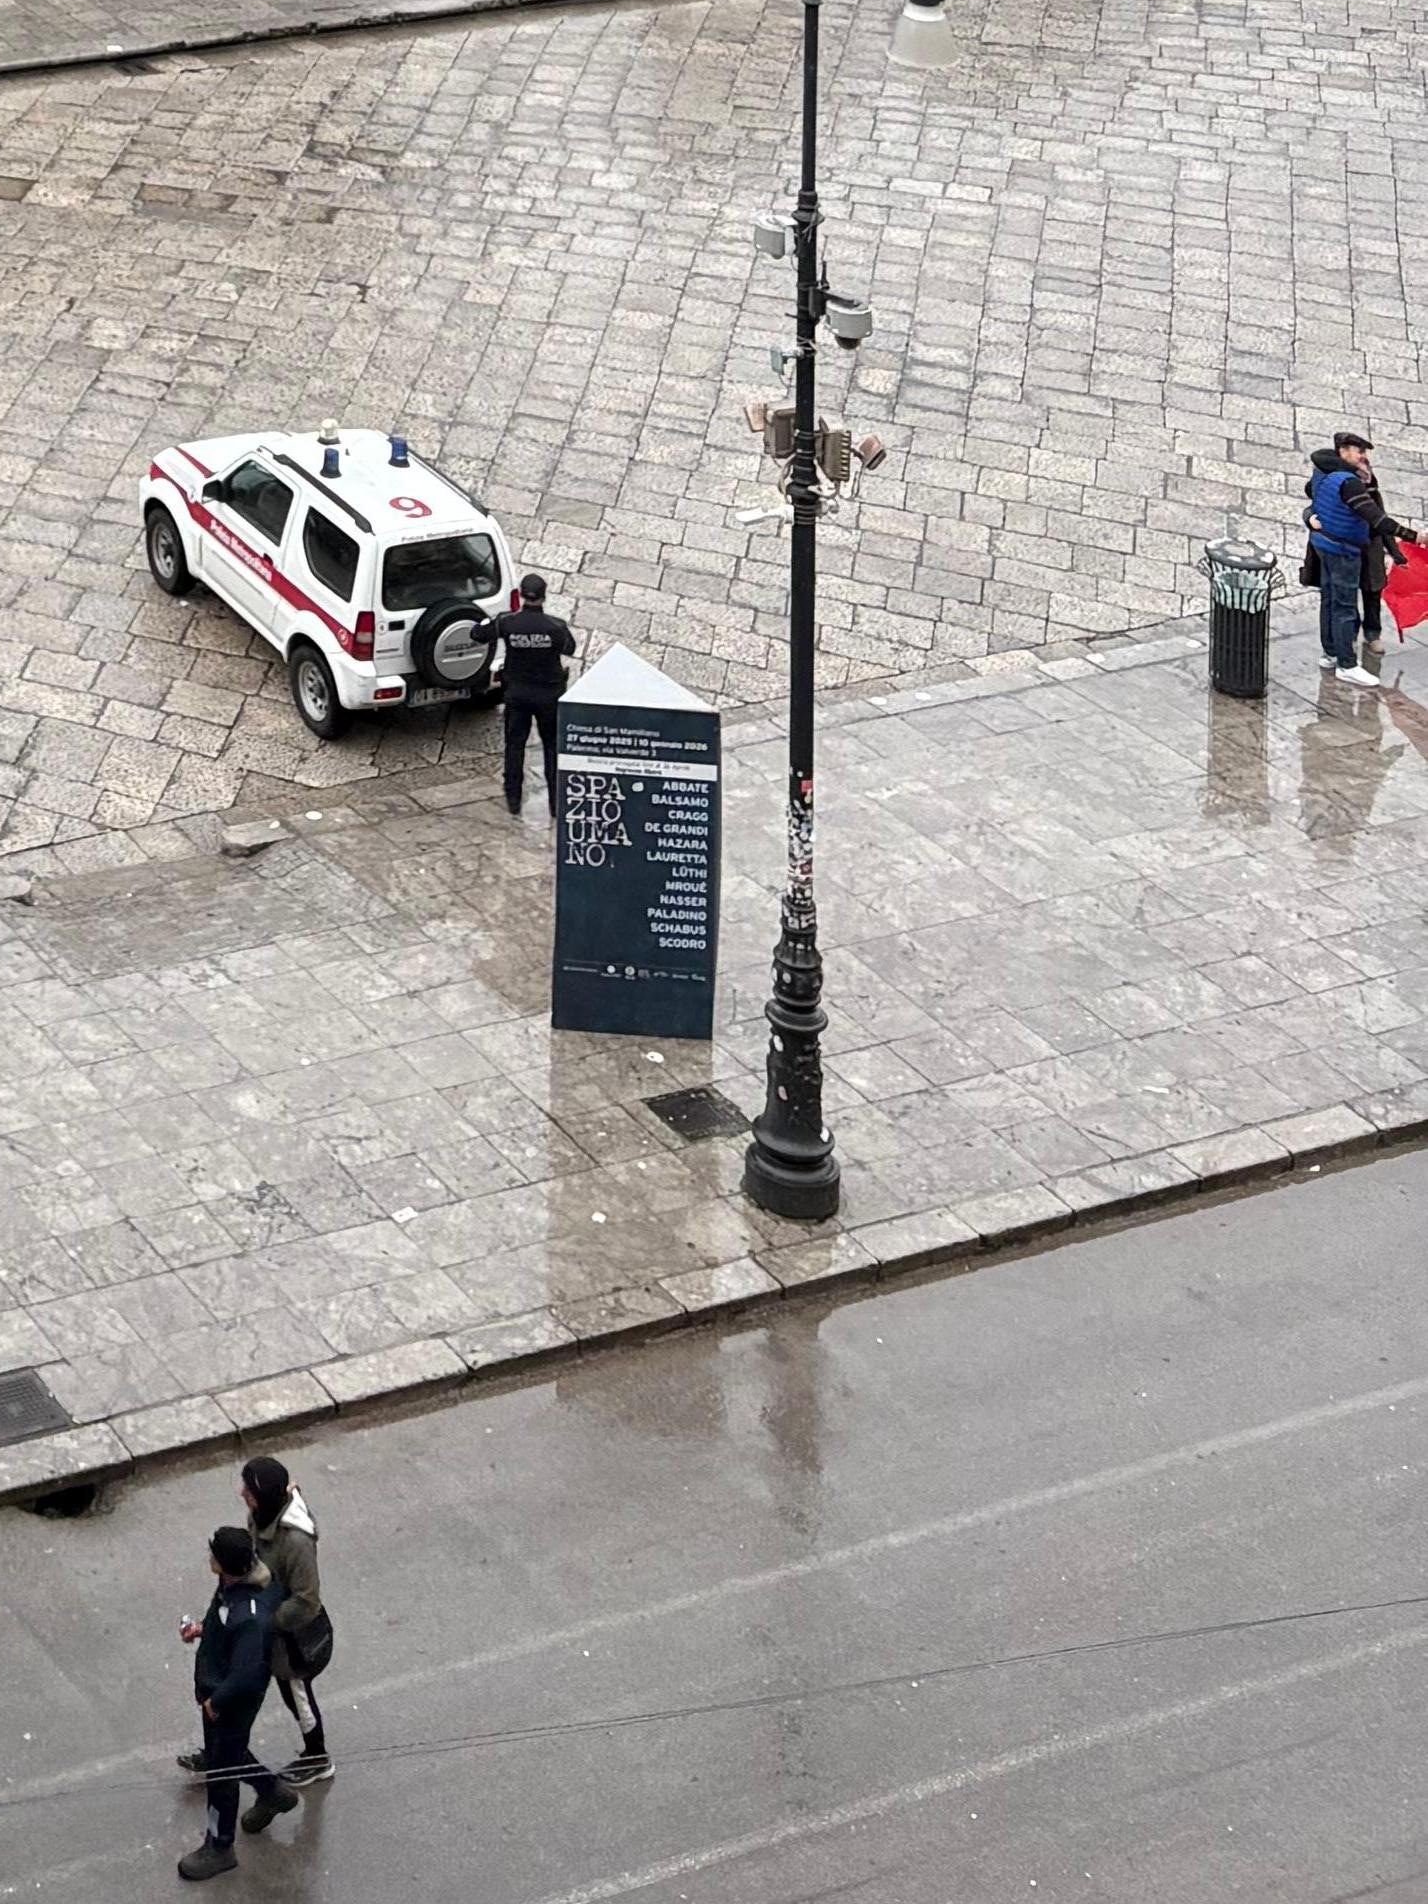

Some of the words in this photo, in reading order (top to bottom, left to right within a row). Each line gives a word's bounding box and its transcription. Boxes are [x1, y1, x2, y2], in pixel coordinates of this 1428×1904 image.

[566, 773, 626, 801] SPA
[662, 781, 709, 794] ABBATE
[651, 793, 709, 808] BALSAMO
[565, 797, 621, 824] ZIO
[667, 809, 709, 822] CRAGG
[565, 820, 633, 846] UMA
[644, 822, 661, 833] DE
[663, 823, 708, 837] GRANDI
[565, 842, 606, 867] NO
[646, 850, 708, 865] LAURETTA
[659, 894, 707, 908] NASSER
[647, 908, 708, 921] PALADINO
[650, 922, 707, 936] SCHABUS
